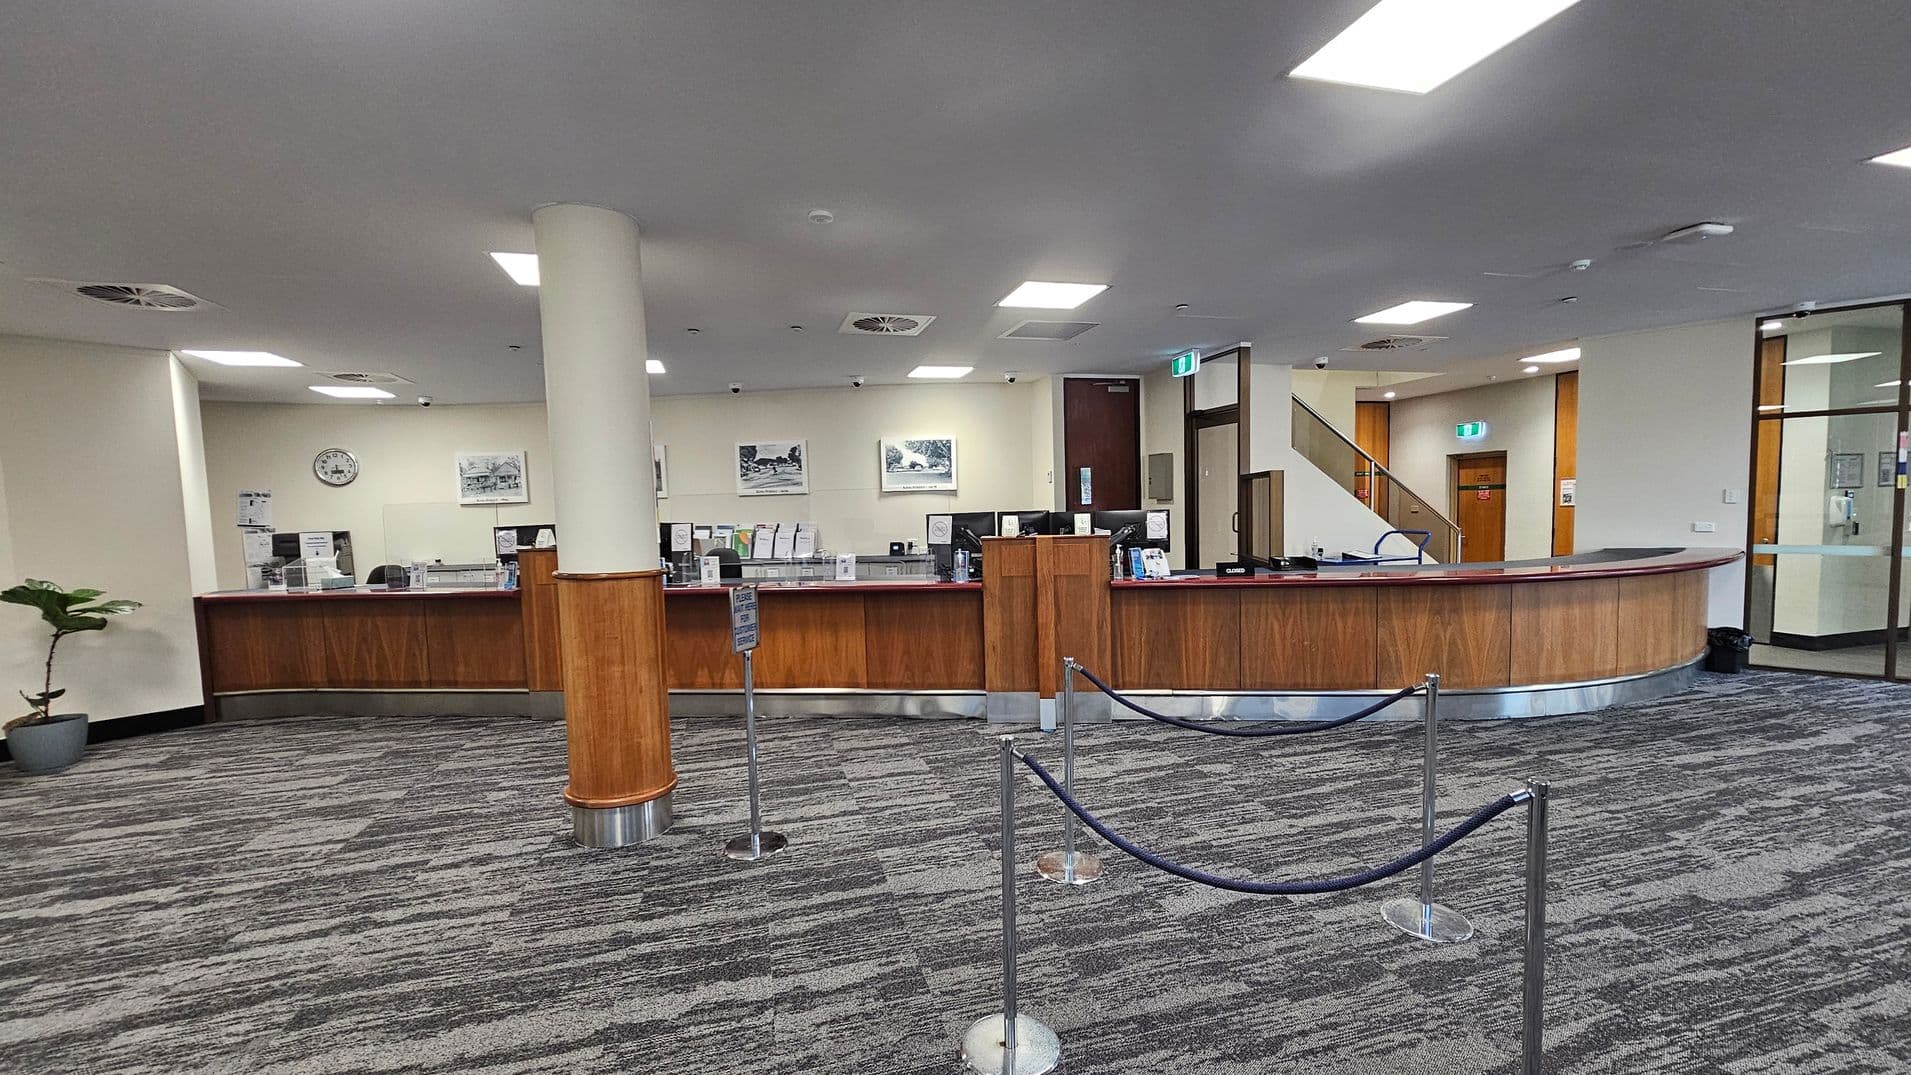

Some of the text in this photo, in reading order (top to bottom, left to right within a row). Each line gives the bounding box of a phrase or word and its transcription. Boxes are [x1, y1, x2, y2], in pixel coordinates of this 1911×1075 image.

[736, 592, 753, 603] PLEASE
[735, 602, 757, 614] WAIT HERE
[740, 613, 750, 623] FOR
[735, 623, 757, 636] CUSTOMER
[737, 634, 755, 647] SERVICE
